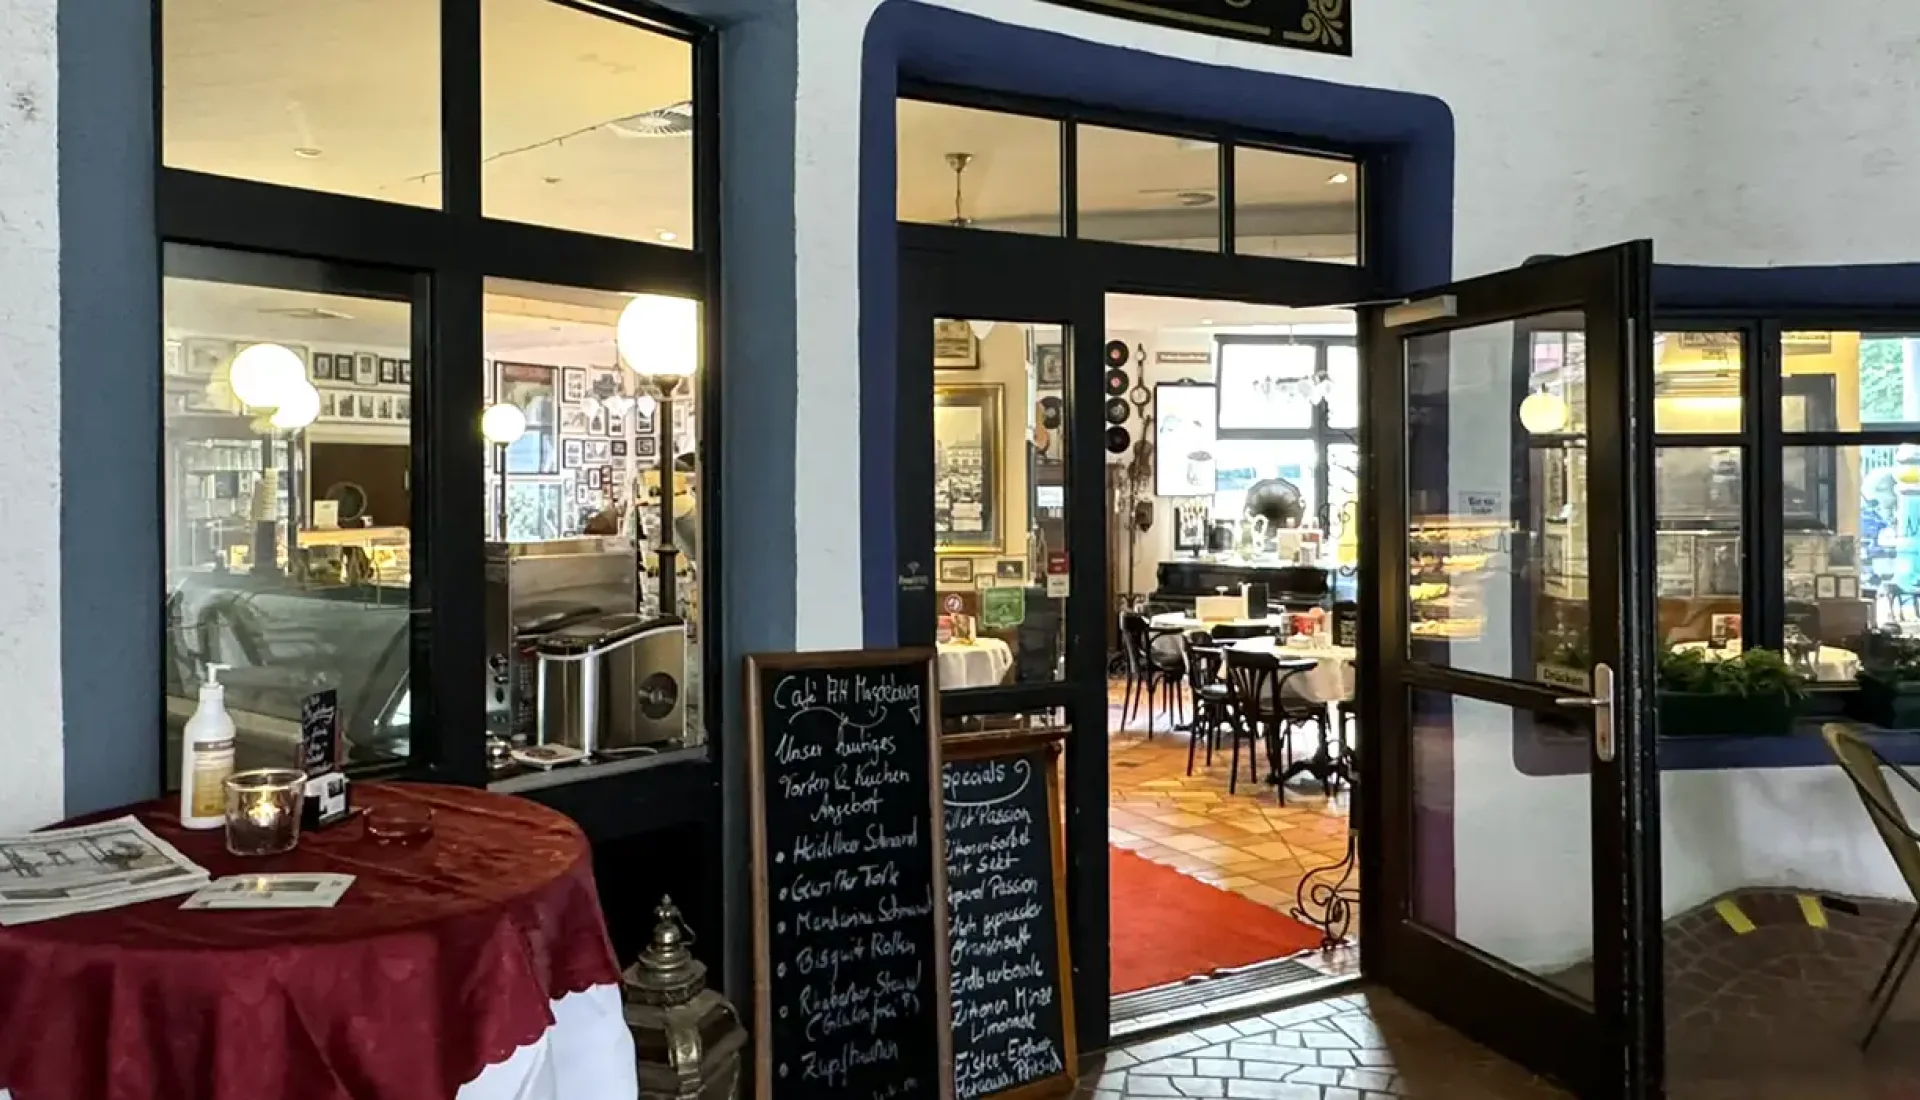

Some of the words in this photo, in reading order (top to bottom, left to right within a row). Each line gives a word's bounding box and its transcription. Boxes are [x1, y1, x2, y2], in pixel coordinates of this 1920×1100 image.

[775, 732, 821, 764] Unser
[855, 761, 909, 786] Kuchen
[811, 788, 884, 825] Angebot
